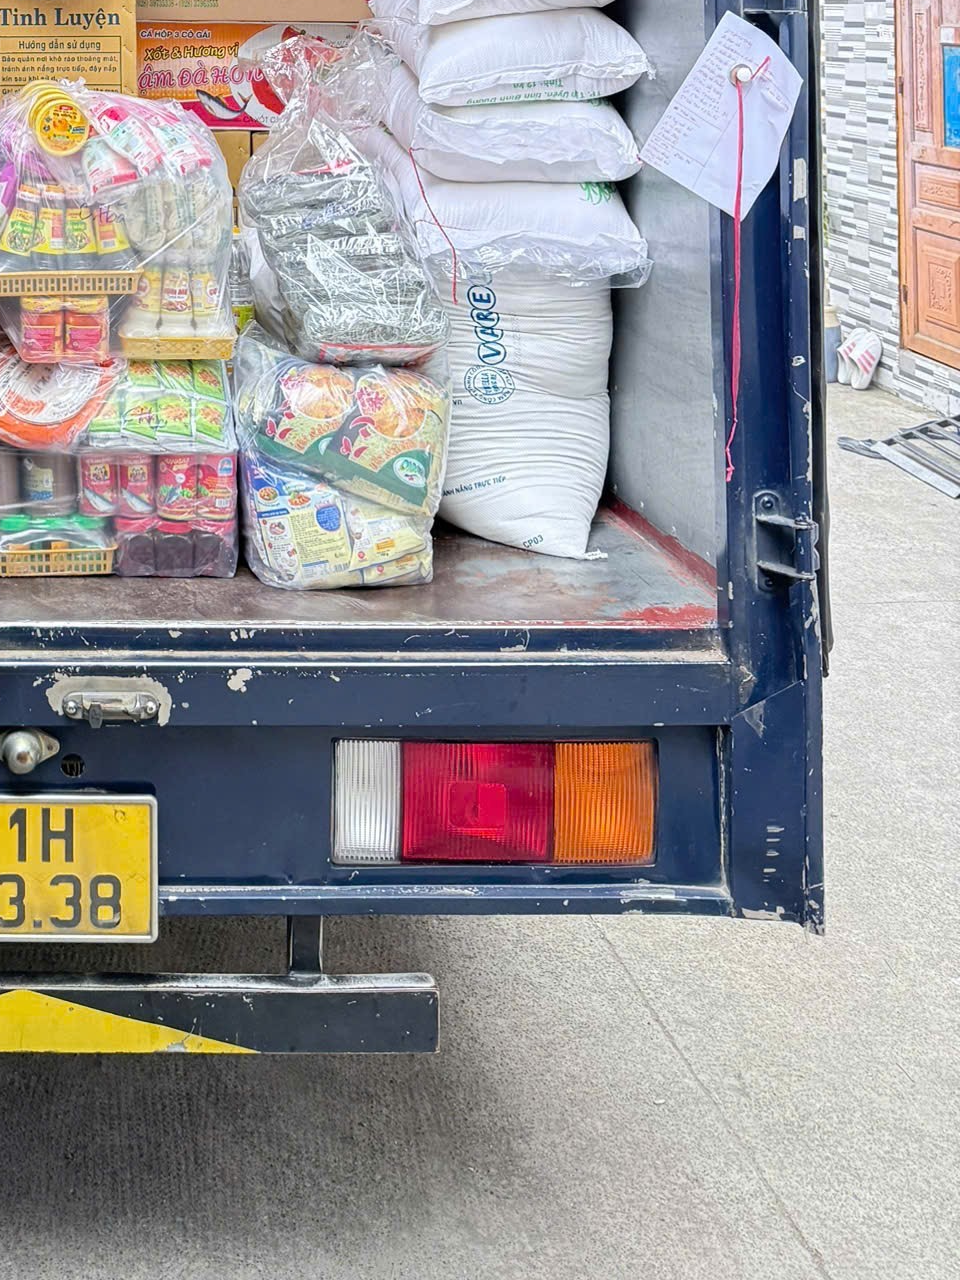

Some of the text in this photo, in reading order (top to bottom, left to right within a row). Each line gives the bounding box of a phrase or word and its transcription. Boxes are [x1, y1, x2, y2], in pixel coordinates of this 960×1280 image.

[54, 8, 120, 30] Luyện
[80, 41, 101, 51] dụng
[144, 44, 169, 61] Xốt
[183, 44, 225, 59] Hương
[227, 42, 239, 58] vị
[523, 535, 543, 548] CP03
